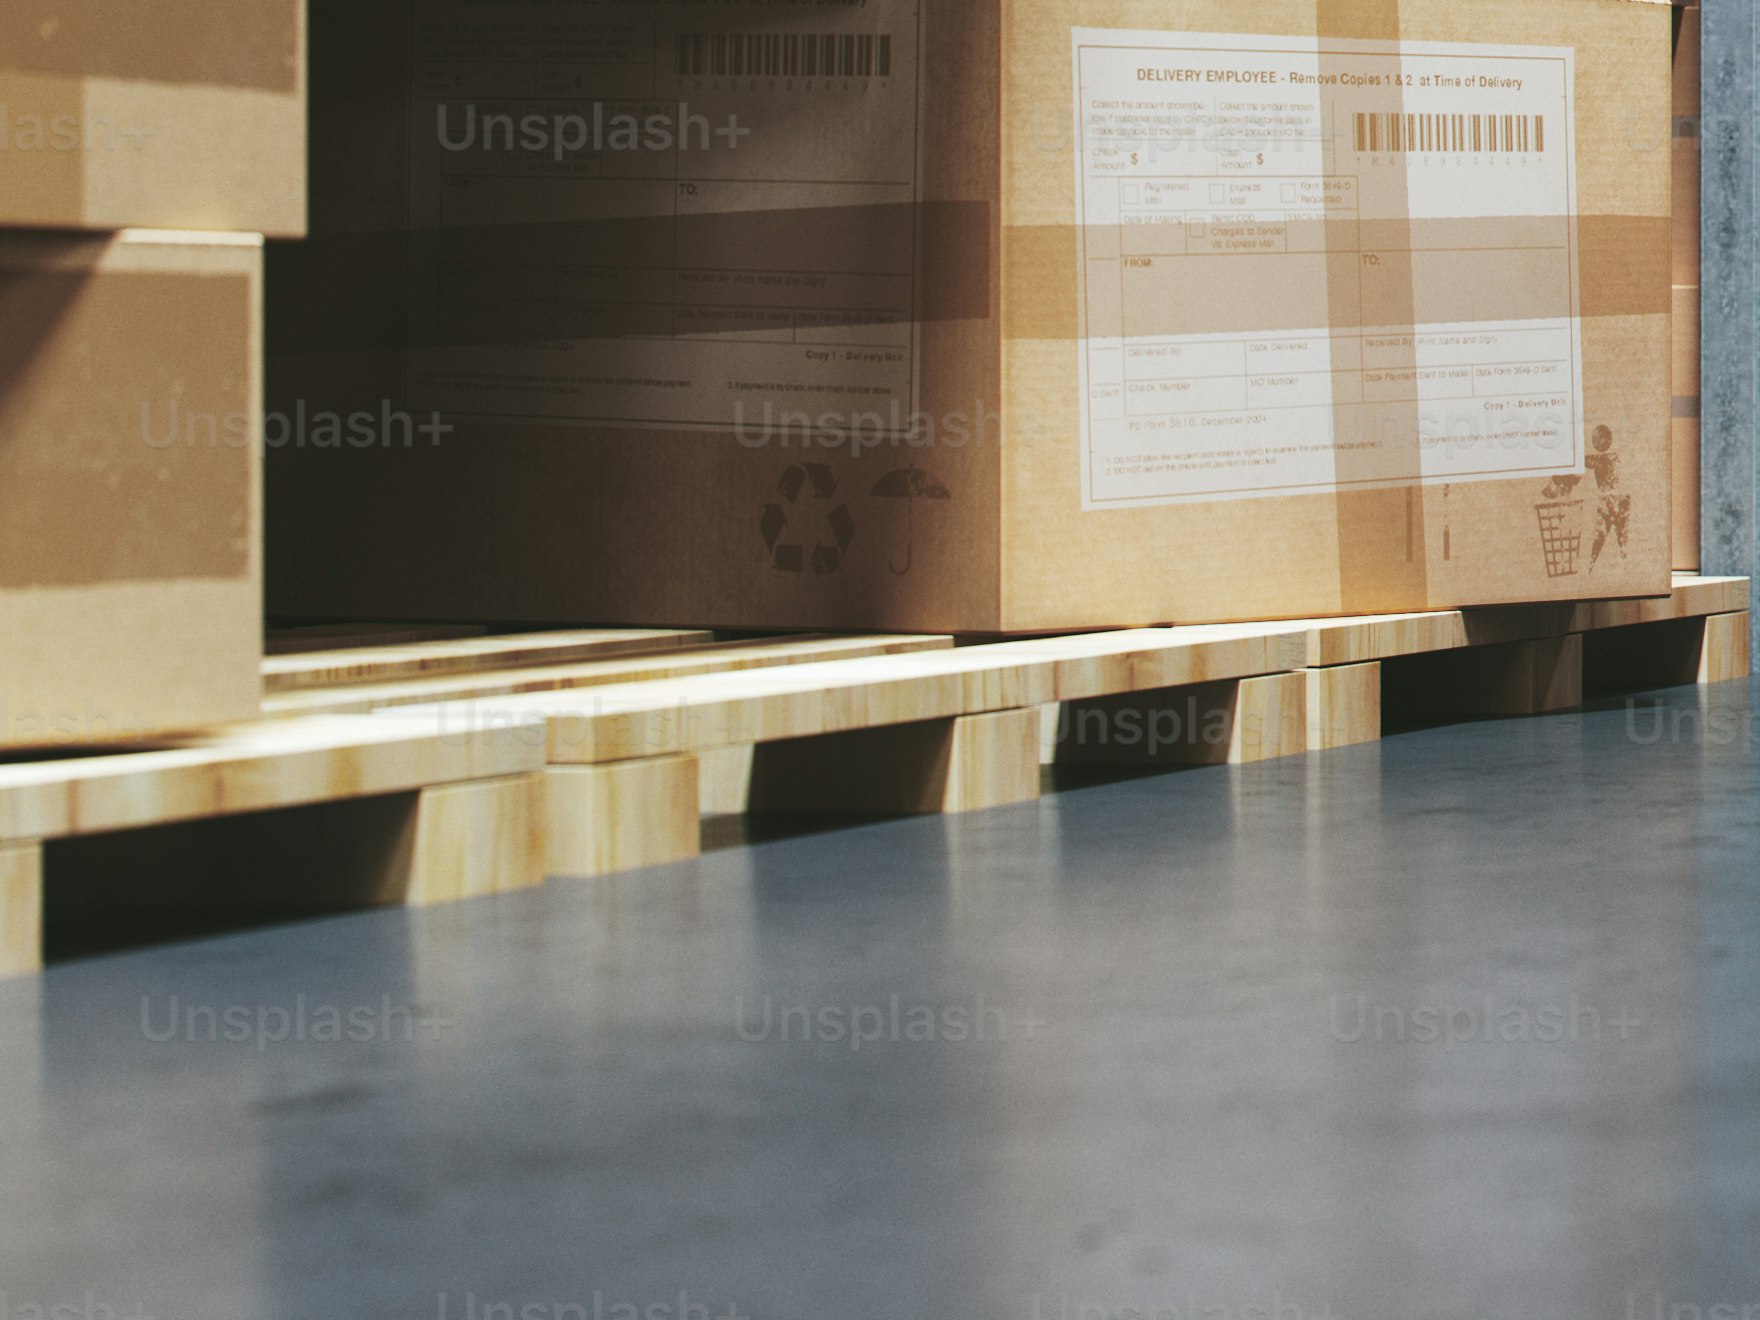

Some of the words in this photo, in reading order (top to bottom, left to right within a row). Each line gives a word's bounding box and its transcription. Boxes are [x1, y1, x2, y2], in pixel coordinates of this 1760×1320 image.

[1137, 68, 1201, 82] DELIVERY
[1207, 70, 1277, 83] EMPLOYEE
[1290, 72, 1337, 85] Remove
[1340, 73, 1380, 88] Copies
[1396, 74, 1403, 86] &
[1406, 74, 1413, 86] 2
[1420, 76, 1431, 87] at
[1434, 75, 1461, 87] Time
[1465, 76, 1476, 87] of
[1479, 76, 1523, 91] Delivery
[1131, 153, 1138, 165] $
[1256, 153, 1264, 165] $
[678, 183, 699, 196] TO:
[1362, 254, 1380, 265] TO:
[1484, 402, 1504, 411] Copy
[1518, 399, 1549, 409] Delivery
